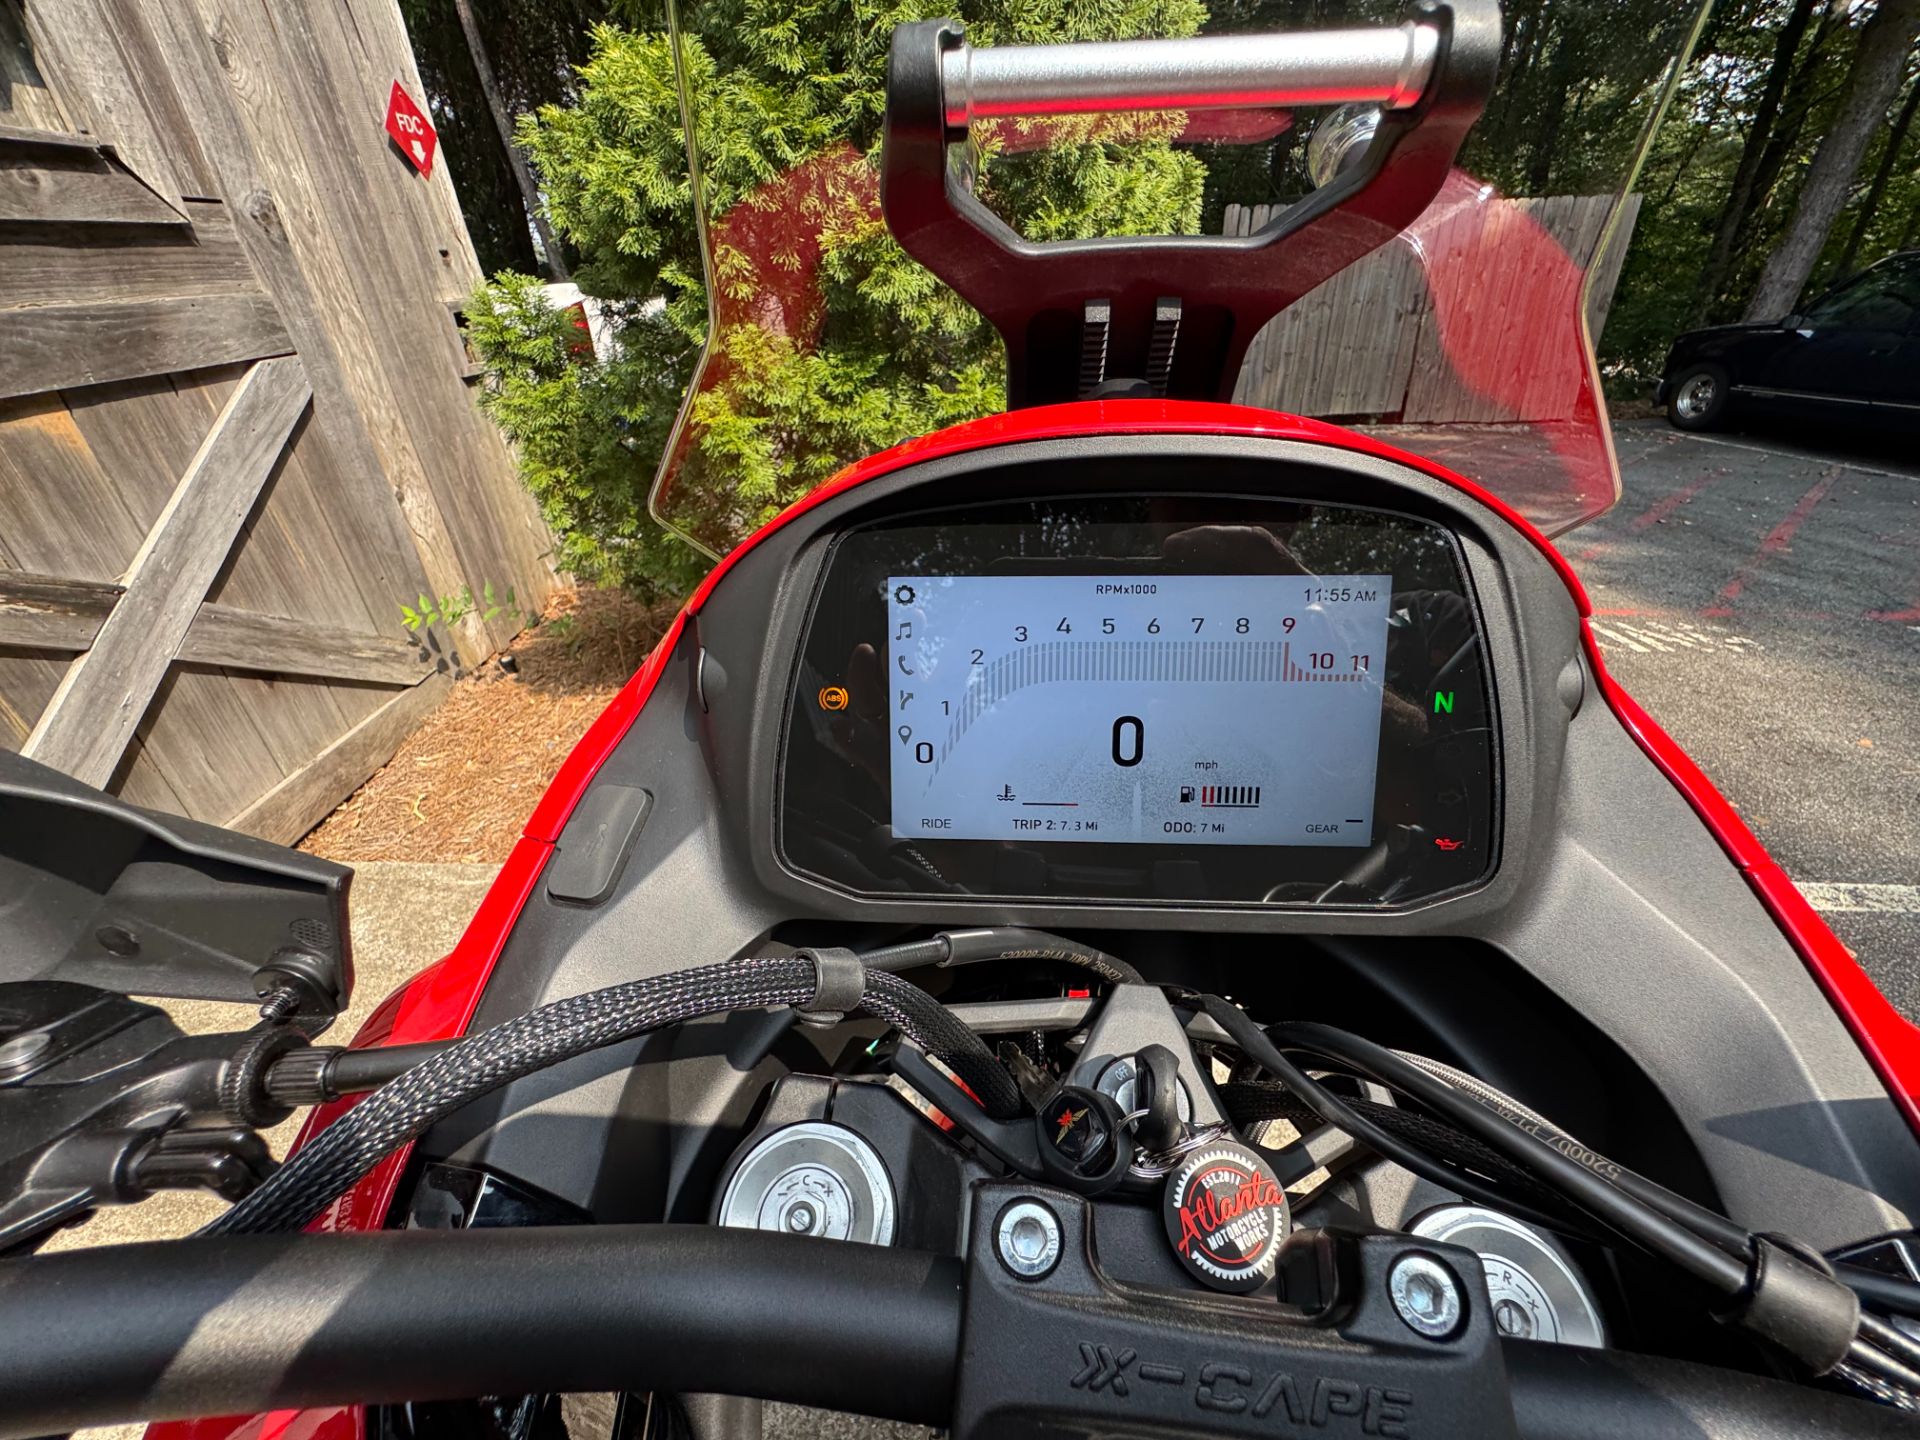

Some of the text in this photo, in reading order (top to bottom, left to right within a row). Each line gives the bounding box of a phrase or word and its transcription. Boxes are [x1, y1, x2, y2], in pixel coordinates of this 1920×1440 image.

[395, 111, 424, 136] FDC
[1096, 584, 1157, 595] RPMx1000
[1304, 588, 1377, 602] 11:55 AM
[1056, 617, 1072, 634] 4
[1102, 618, 1116, 634] 5
[1147, 618, 1161, 634] 6
[1191, 618, 1205, 634] 7
[1235, 618, 1250, 634] 8
[1282, 618, 1296, 634] 9
[1014, 626, 1028, 642] 3
[971, 649, 984, 665] 2
[1309, 653, 1334, 669] 10
[1350, 655, 1370, 671] 11
[941, 701, 949, 716] 1
[1434, 691, 1454, 713] N
[1111, 715, 1144, 767] 0
[916, 742, 933, 763] 0
[1194, 760, 1218, 770] mph
[921, 818, 952, 829] RIDE
[1013, 819, 1042, 830] TRIP
[1046, 820, 1057, 831] 2:
[1085, 821, 1098, 831] Mi
[1163, 822, 1225, 833] ODO: 7 Mi
[1305, 824, 1339, 833] GEAR
[1115, 1065, 1128, 1081] OFF
[802, 1174, 810, 1186] C
[1178, 1171, 1284, 1259] Atlanta
[1206, 1207, 1269, 1251] MOTORCYCLE
[1234, 1223, 1269, 1251] WORKS
[1503, 1270, 1512, 1285] R
